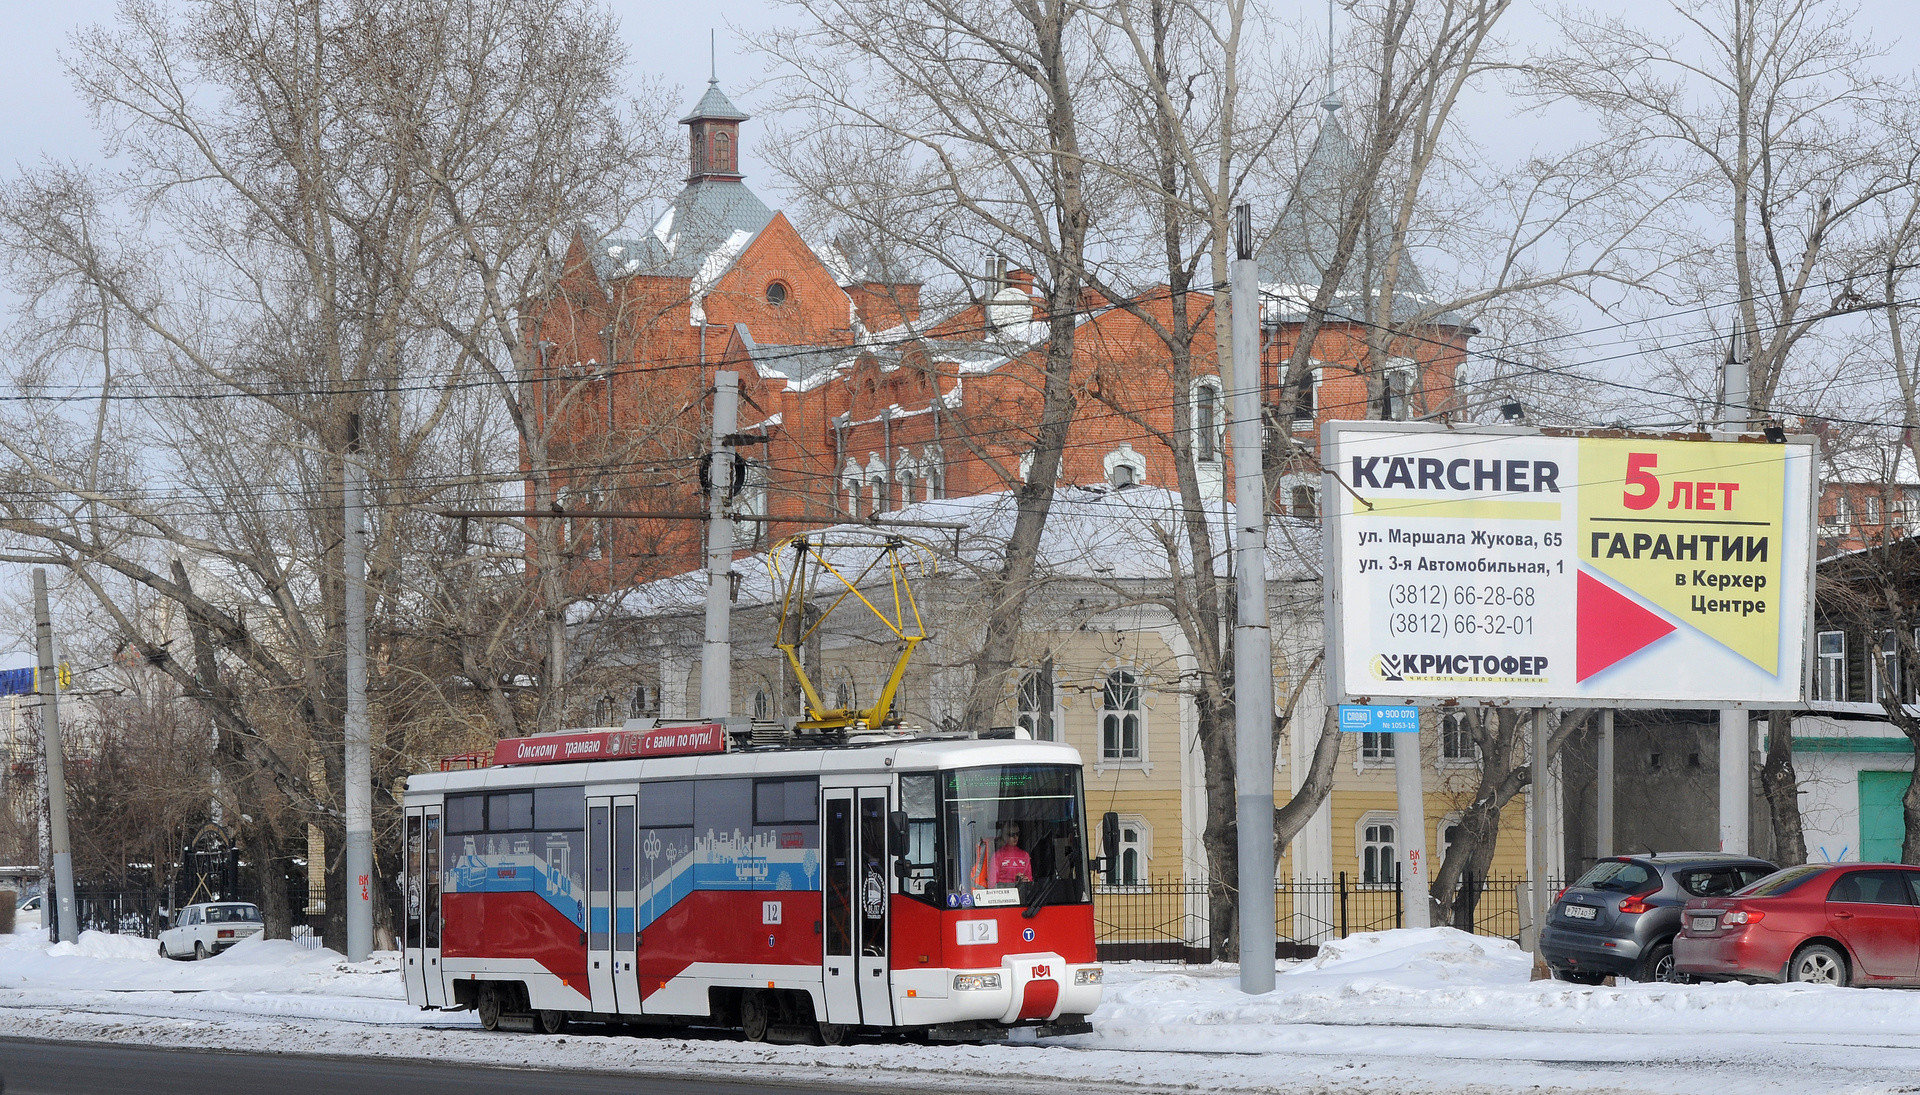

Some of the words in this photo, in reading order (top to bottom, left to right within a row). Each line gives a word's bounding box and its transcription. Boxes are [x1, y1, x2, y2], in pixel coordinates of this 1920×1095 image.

[1353, 456, 1561, 493] KÄRCHER
[1623, 452, 1660, 510] 5
[1668, 481, 1739, 511] ЛЕТ
[1358, 531, 1383, 546] ул.
[1388, 529, 1466, 547] Маршала
[1471, 530, 1538, 549] Жукова,
[1543, 532, 1562, 547] 65
[1591, 532, 1769, 562] ГАРАНТИИ
[1359, 558, 1383, 573] ул.
[1388, 556, 1412, 571] 3-я
[1417, 557, 1550, 576] Автомобильная,
[1556, 559, 1564, 574] 1
[1675, 573, 1686, 586] в
[1692, 570, 1766, 592] Керхер
[1388, 584, 1448, 609] (3812)
[1454, 585, 1535, 606] 66-28-68
[1691, 595, 1766, 617] Центре
[1389, 613, 1448, 638] (3812)
[1454, 614, 1534, 635] 66-32-01
[1403, 654, 1549, 676] КРИСТОФЕР
[1385, 709, 1399, 718] 900
[1401, 710, 1415, 719] 070
[517, 742, 558, 759] Омскому
[564, 740, 600, 758] трамваю
[645, 739, 650, 749] с
[653, 736, 676, 750] вами
[677, 735, 688, 747] по
[689, 728, 713, 750] пути!
[1413, 866, 1418, 875] 2
[975, 893, 982, 901] 4
[767, 904, 778, 921] 12
[967, 922, 990, 942] 12
